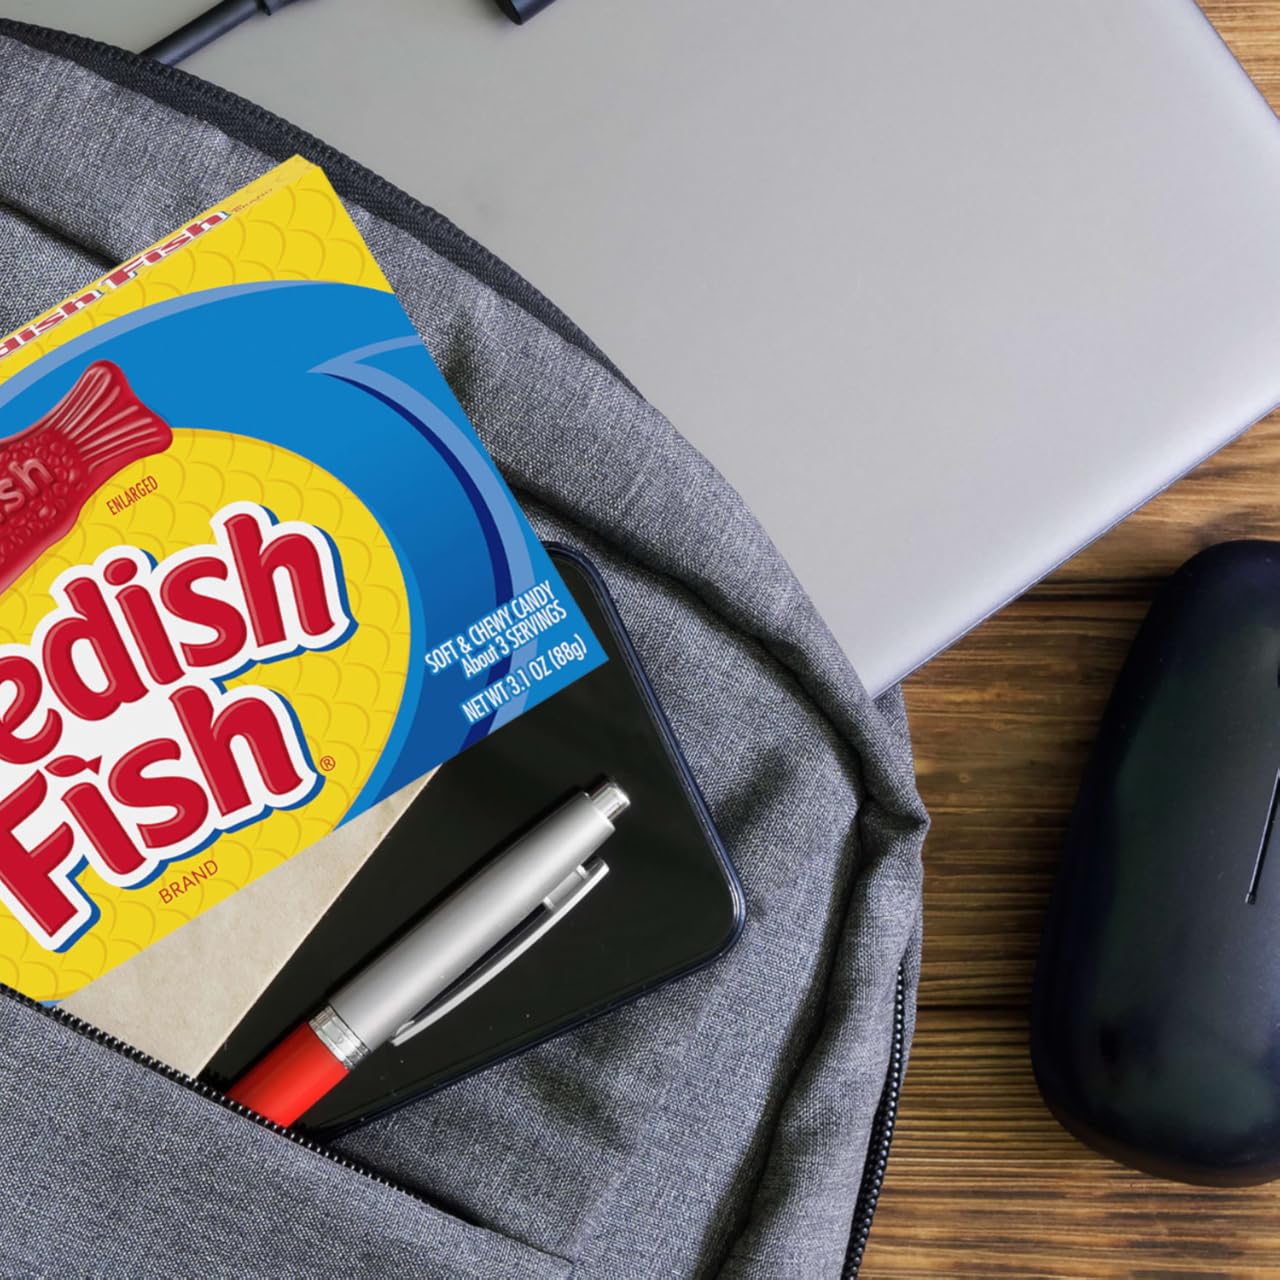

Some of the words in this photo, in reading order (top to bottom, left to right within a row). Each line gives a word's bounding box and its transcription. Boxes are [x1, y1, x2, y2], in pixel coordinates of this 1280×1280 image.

[98, 211, 231, 288] Fish
[106, 474, 158, 516] ENLARGED
[425, 640, 459, 673] SOFT
[457, 636, 472, 653] &
[468, 605, 513, 645] CHEWY
[511, 580, 555, 619] CANDY
[461, 647, 500, 678] About
[496, 638, 509, 654] 3
[507, 600, 567, 648] SERVINGS
[462, 692, 487, 723] NET
[484, 681, 509, 711] WT
[506, 669, 531, 696] 3.1
[528, 656, 552, 681] OZ
[548, 633, 587, 670] (88g)
[158, 860, 218, 904] BRAND
